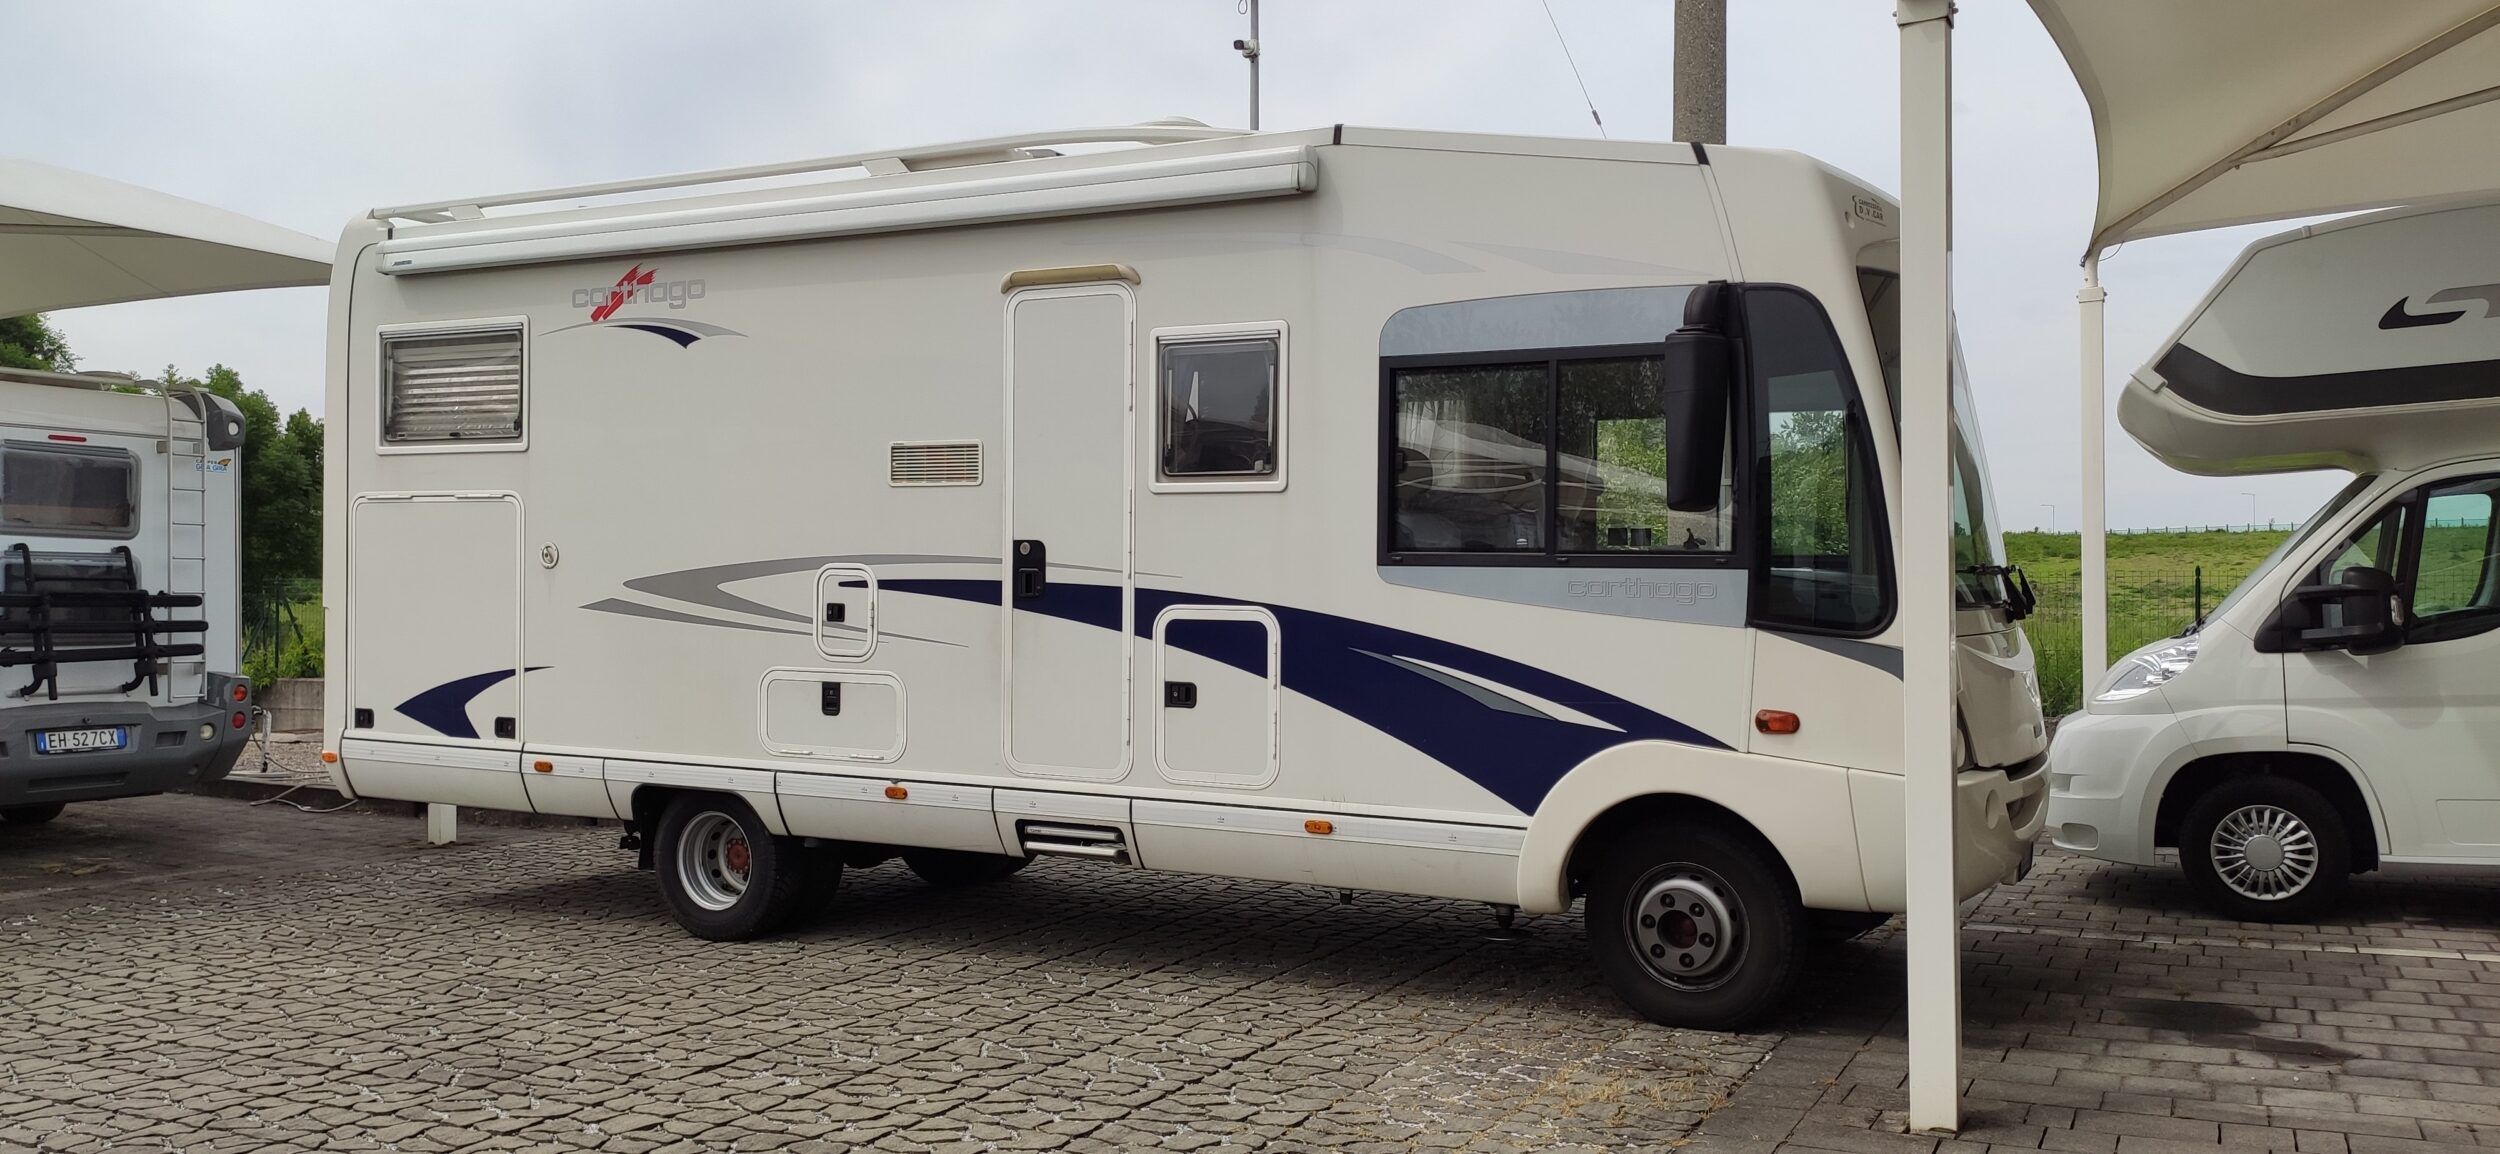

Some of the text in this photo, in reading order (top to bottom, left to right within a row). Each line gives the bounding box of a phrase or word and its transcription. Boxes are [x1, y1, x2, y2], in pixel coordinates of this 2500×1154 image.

[571, 278, 706, 309] carthago
[1567, 577, 1718, 606] carthago
[48, 730, 117, 749] EH 527CX
